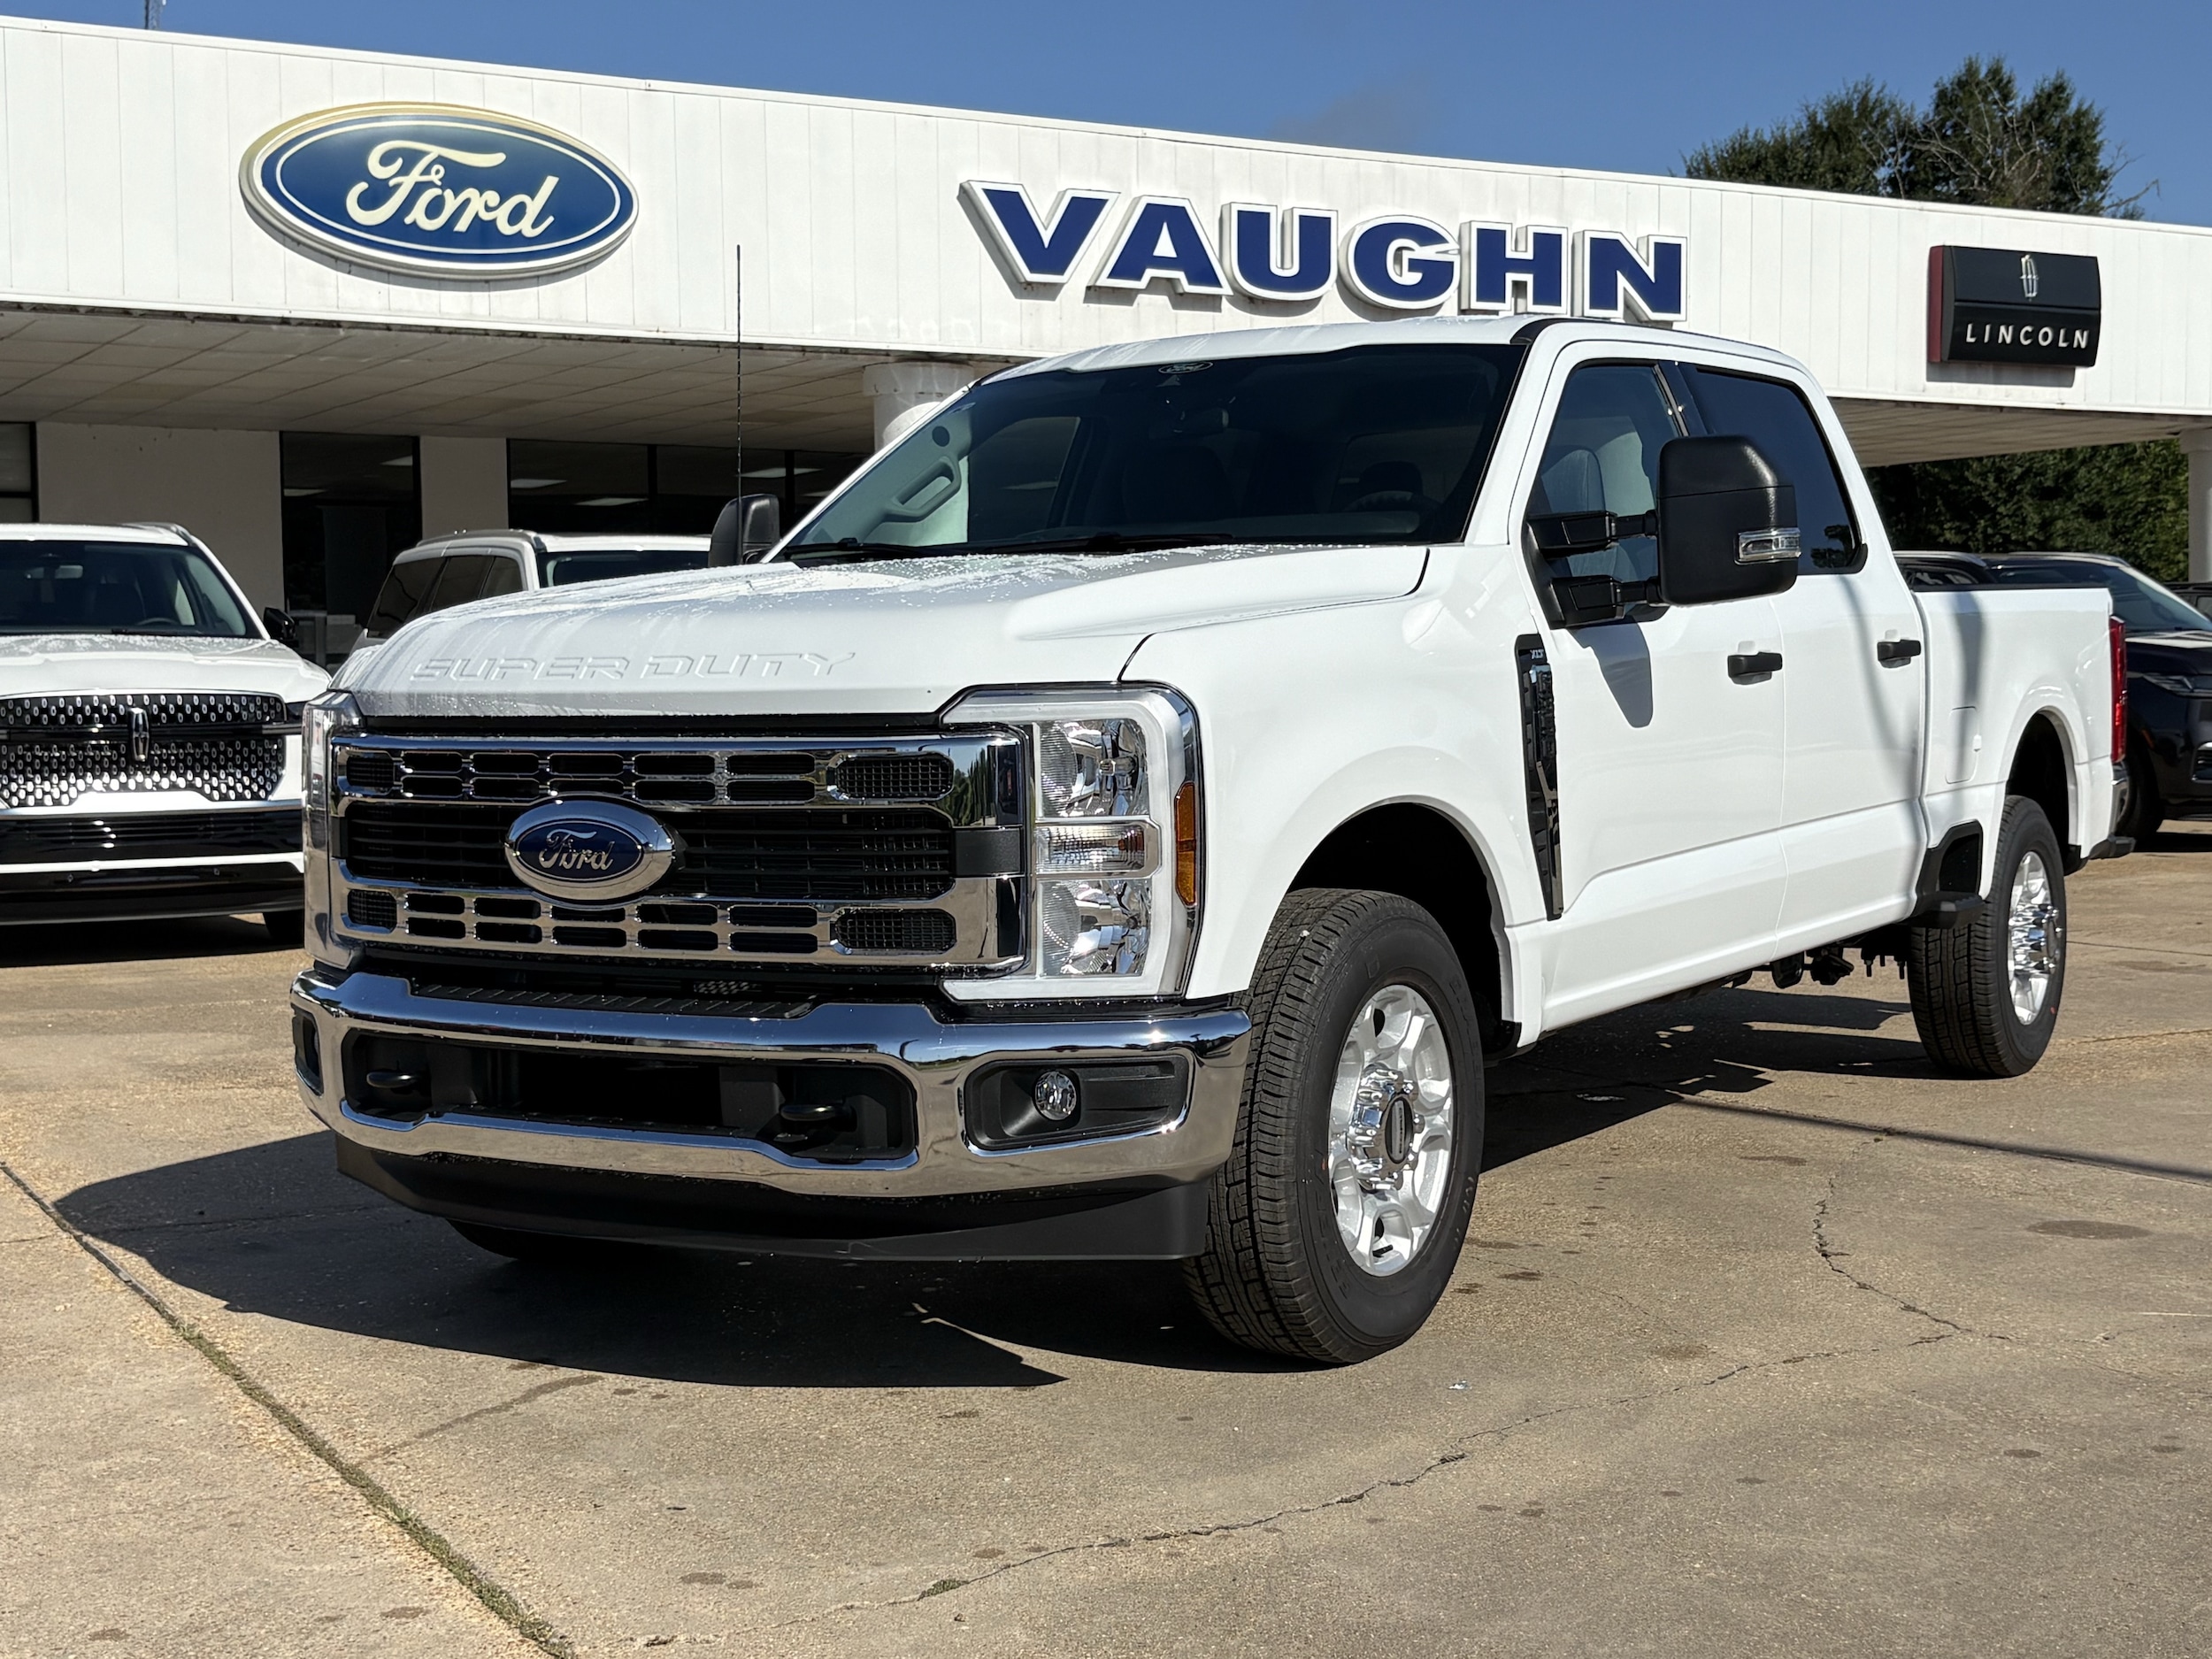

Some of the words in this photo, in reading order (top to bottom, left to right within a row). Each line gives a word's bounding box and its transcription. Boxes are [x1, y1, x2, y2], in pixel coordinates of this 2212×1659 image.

[346, 140, 559, 237] Ford
[958, 180, 1687, 322] VAUGHN
[1966, 323, 2088, 349] LINCOLN
[410, 656, 630, 682] SUPER
[639, 652, 856, 680] DUTY
[538, 828, 615, 871] Ford
